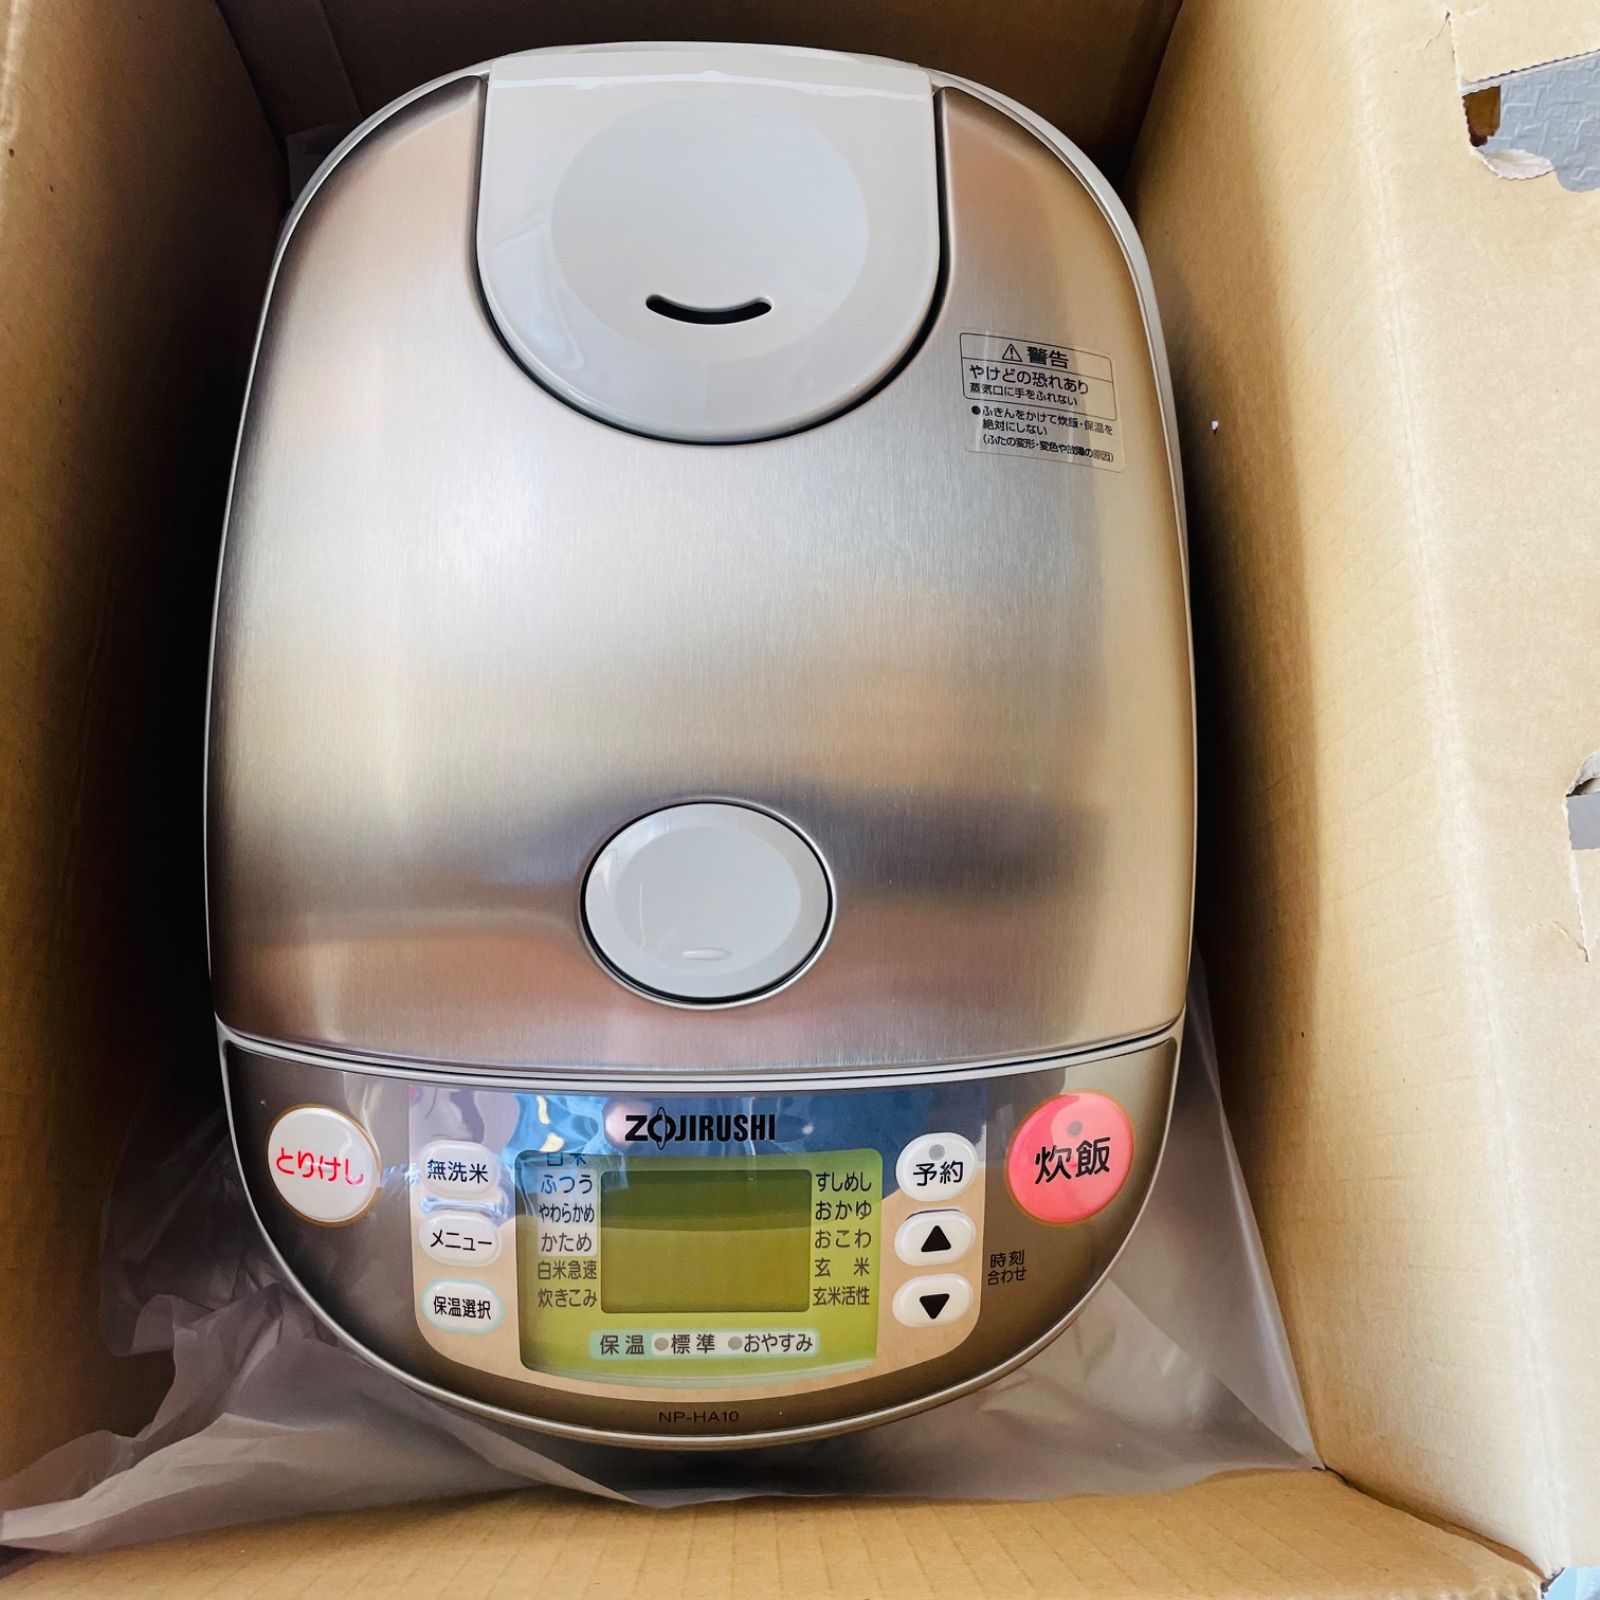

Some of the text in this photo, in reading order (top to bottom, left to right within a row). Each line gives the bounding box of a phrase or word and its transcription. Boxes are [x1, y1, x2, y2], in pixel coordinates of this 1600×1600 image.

[1026, 345, 1069, 369] 警告
[969, 364, 1089, 395] やけどの恐れあり
[969, 382, 1078, 406] 蒸気口に手をふれない
[982, 418, 1048, 435] 絶対にしない
[625, 1108, 776, 1149] ZOJIRUSHI
[276, 1147, 364, 1185] とりけし
[1034, 1136, 1111, 1184] 炊飯
[427, 1159, 489, 1184] 無洗米
[815, 1172, 872, 1192] すしめし
[913, 1160, 964, 1186] 予約
[541, 1174, 593, 1194] ふつう
[539, 1203, 595, 1224] やわらかめ
[815, 1200, 872, 1221] おかゆ
[430, 1229, 493, 1251] メニュー
[541, 1232, 592, 1252] かため
[814, 1229, 872, 1249] おこわ
[990, 1250, 1025, 1268] 時刻
[537, 1260, 597, 1281] 白米急速
[987, 1266, 1027, 1286] 合わせ
[537, 1288, 598, 1308] 炊きこみ
[812, 1285, 870, 1306] 玄米活性
[433, 1295, 492, 1320] 保温選択
[600, 1333, 813, 1355] 保温 標準 おやすみ
[658, 1411, 739, 1423] NP-HA10
